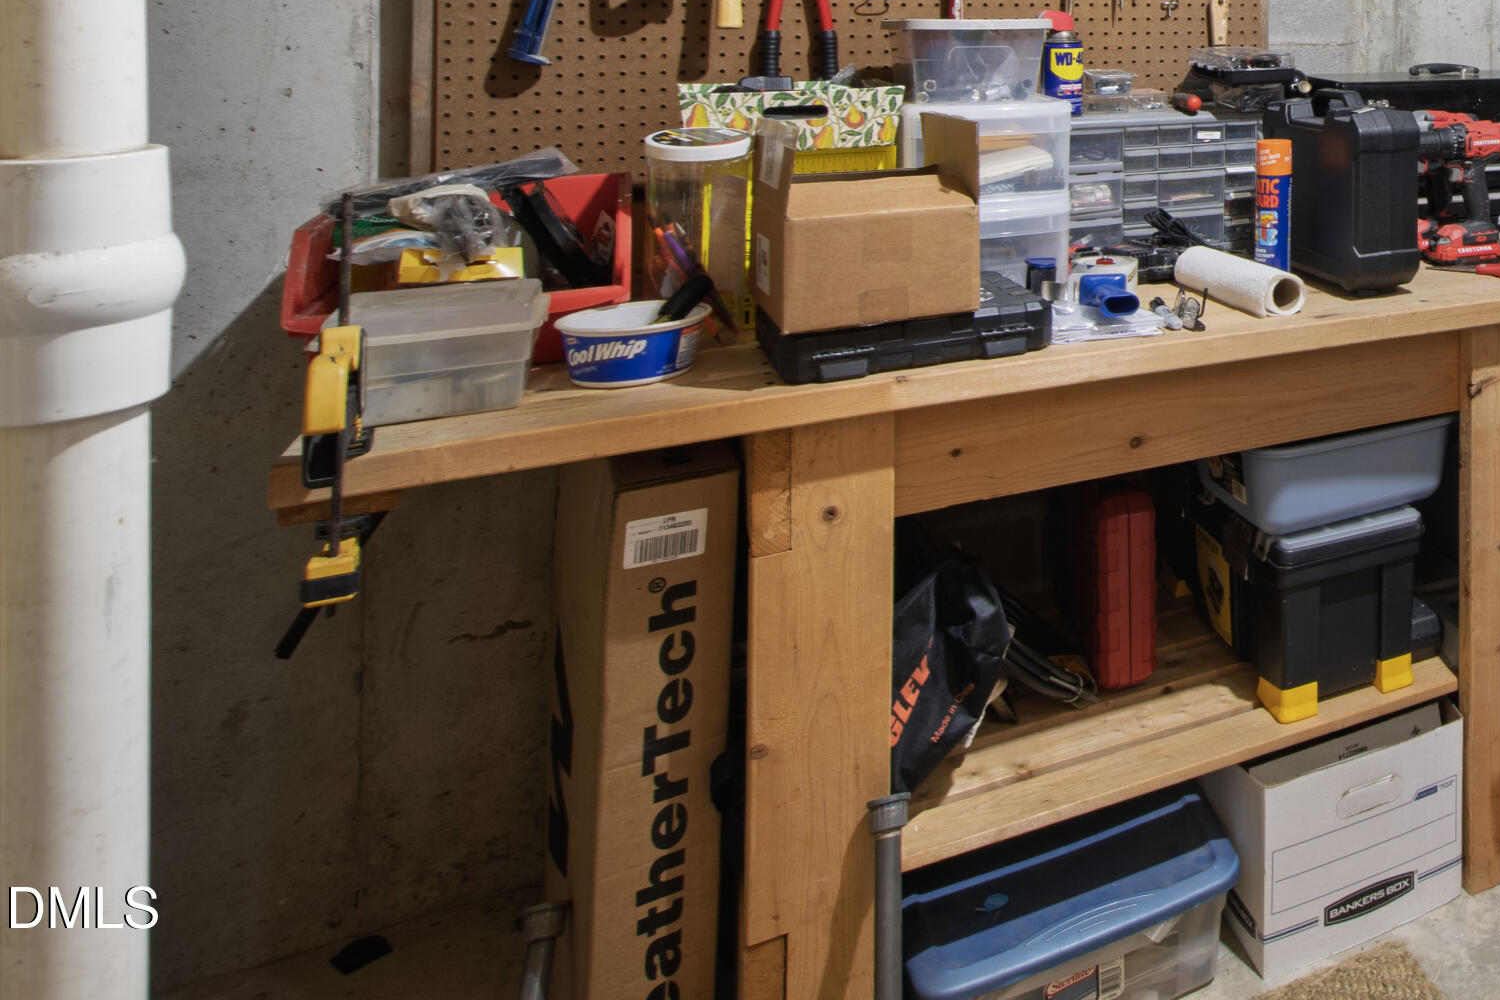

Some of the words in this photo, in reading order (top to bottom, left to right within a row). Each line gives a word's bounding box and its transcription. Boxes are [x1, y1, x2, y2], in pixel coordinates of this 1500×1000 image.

[1457, 245, 1493, 254] CRAFTSMAN
[568, 345, 595, 366] Cool
[594, 339, 648, 362] Whip
[1328, 887, 1381, 922] BANKERS
[1382, 875, 1410, 899] BOX
[1044, 963, 1098, 998] Sterilite
